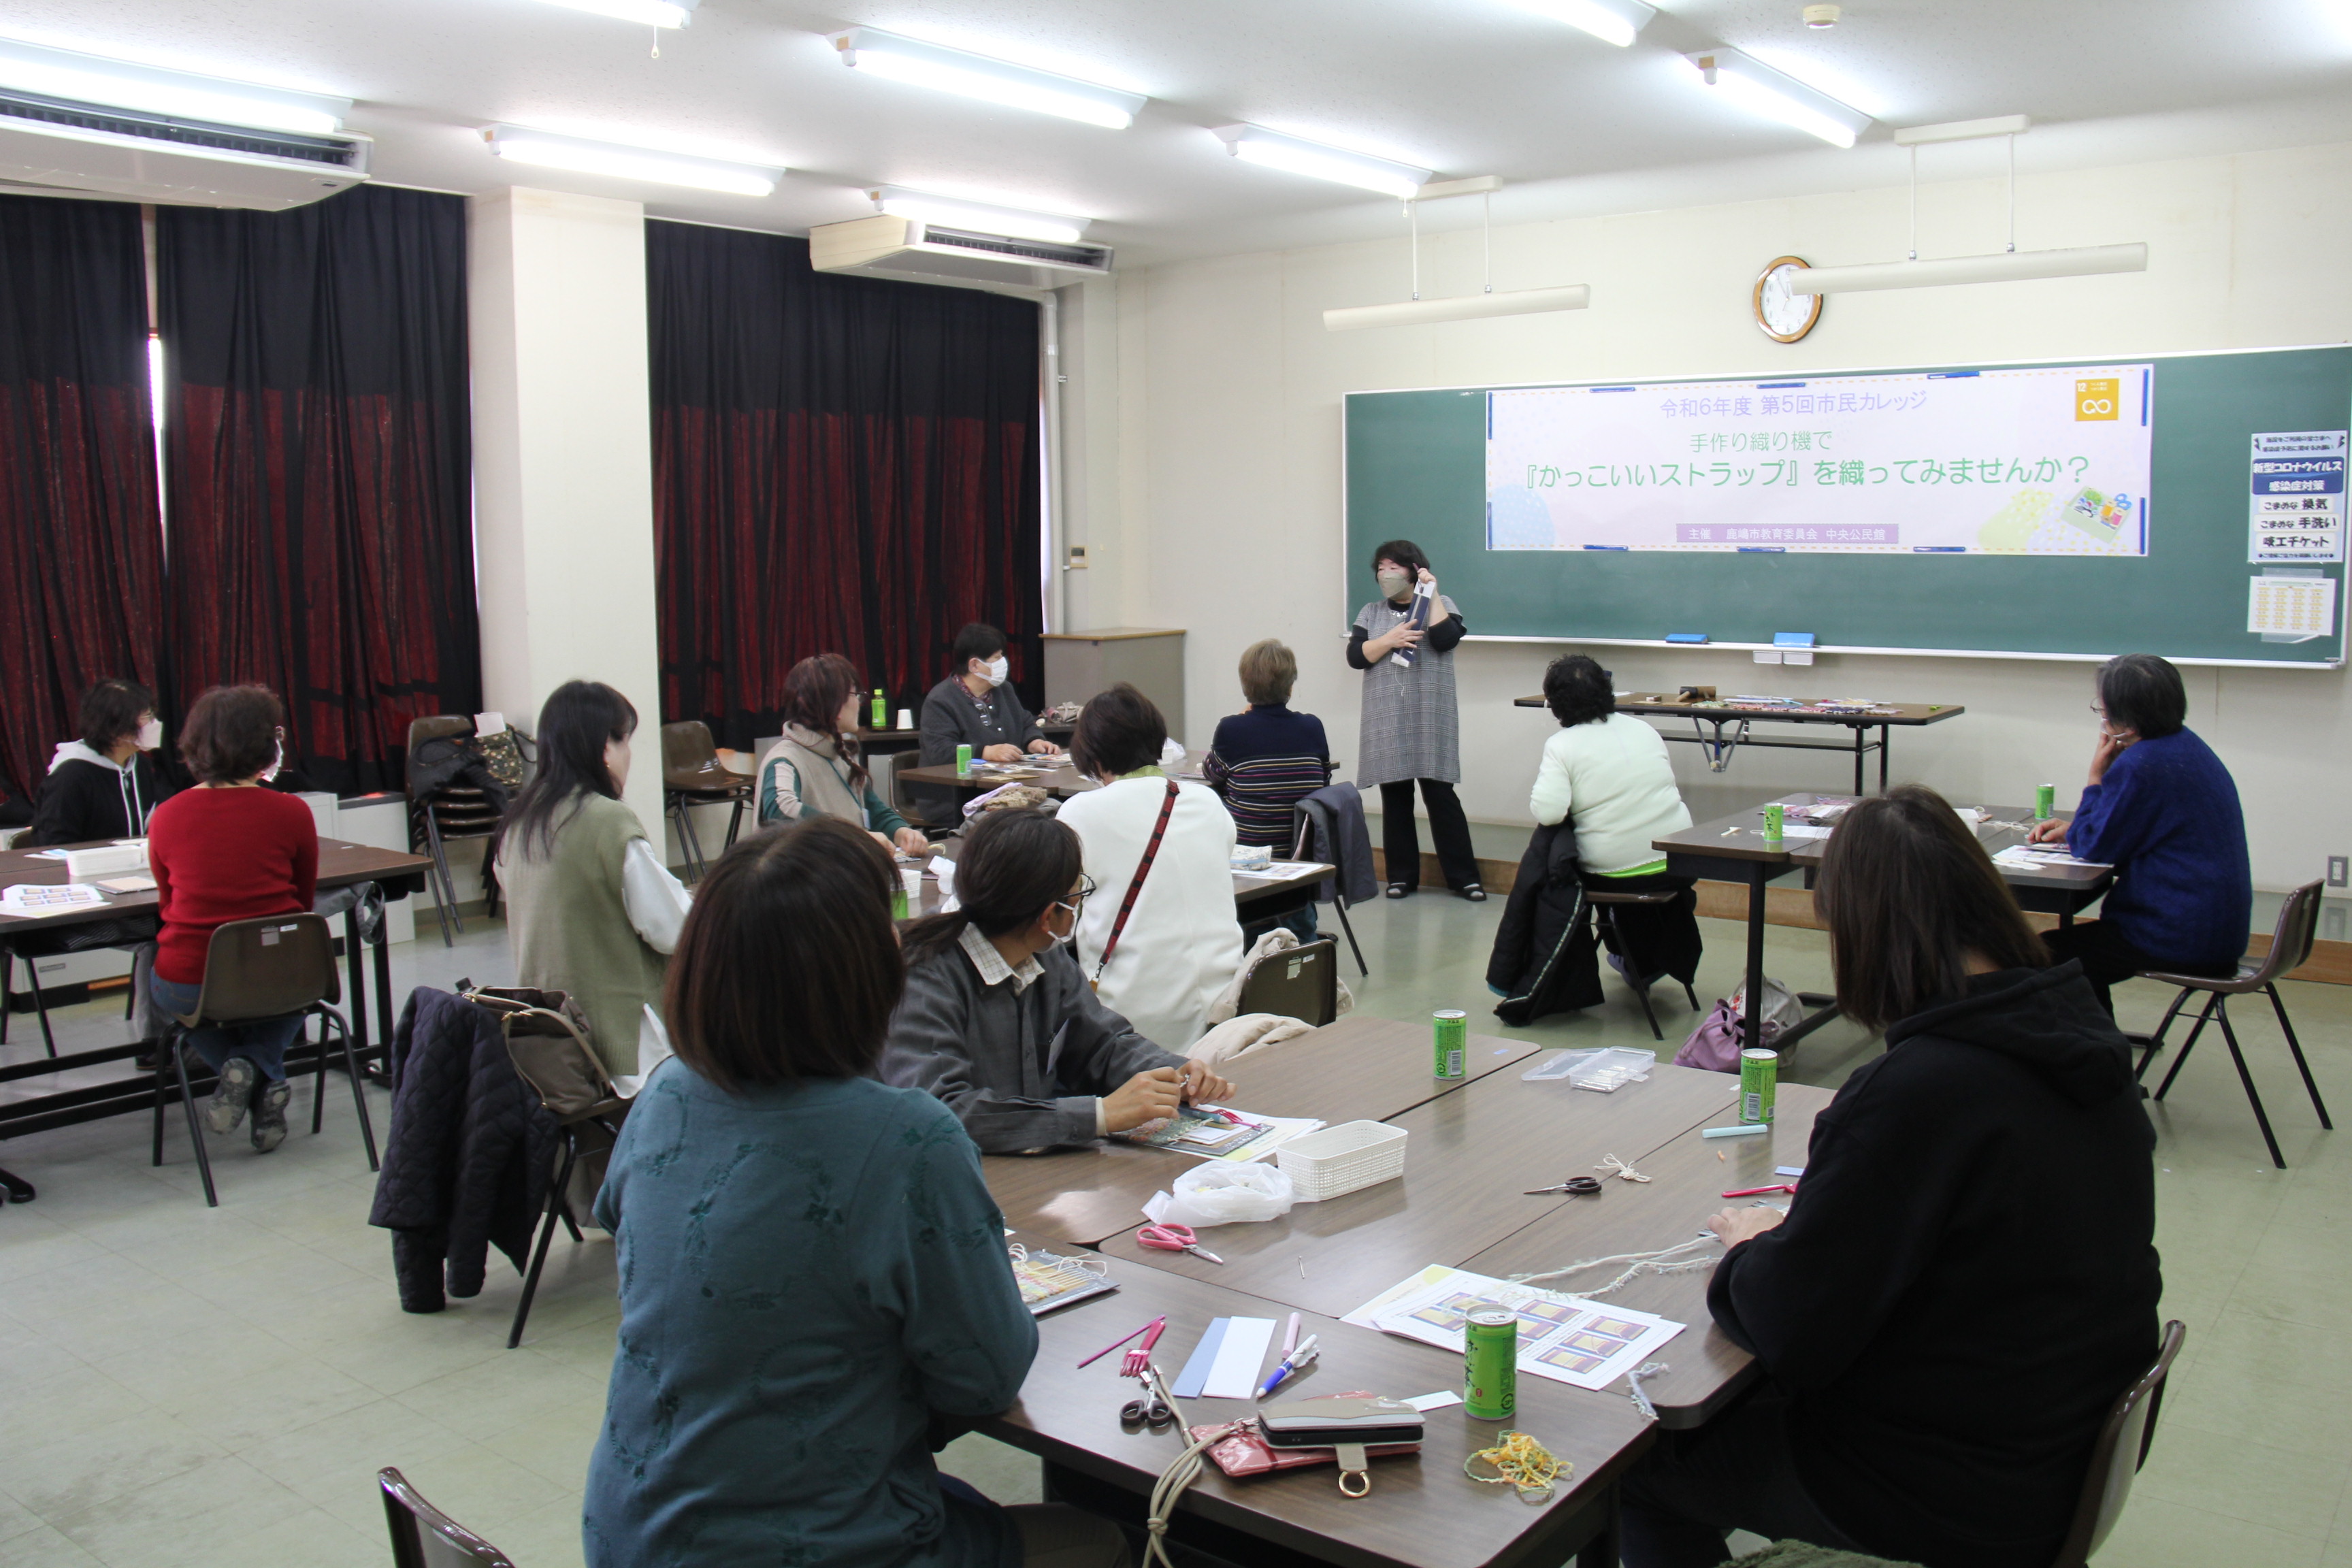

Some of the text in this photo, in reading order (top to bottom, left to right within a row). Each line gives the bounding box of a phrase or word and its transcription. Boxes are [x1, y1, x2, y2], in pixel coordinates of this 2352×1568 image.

[2077, 382, 2087, 392] 12
[1659, 390, 1927, 419] 令和6年度 第5回市民カレッジ
[1689, 430, 1833, 453] 手作り織り機で
[2253, 461, 2342, 474] 新型コロナウイルス
[2268, 480, 2325, 491] 感染症対策
[2264, 498, 2328, 510] こまめな 換気
[2298, 517, 2336, 528] 手洗い
[1688, 528, 1712, 540] 主催
[1826, 528, 1886, 540] 中央公民館
[2263, 536, 2329, 547] 咳エチケット
